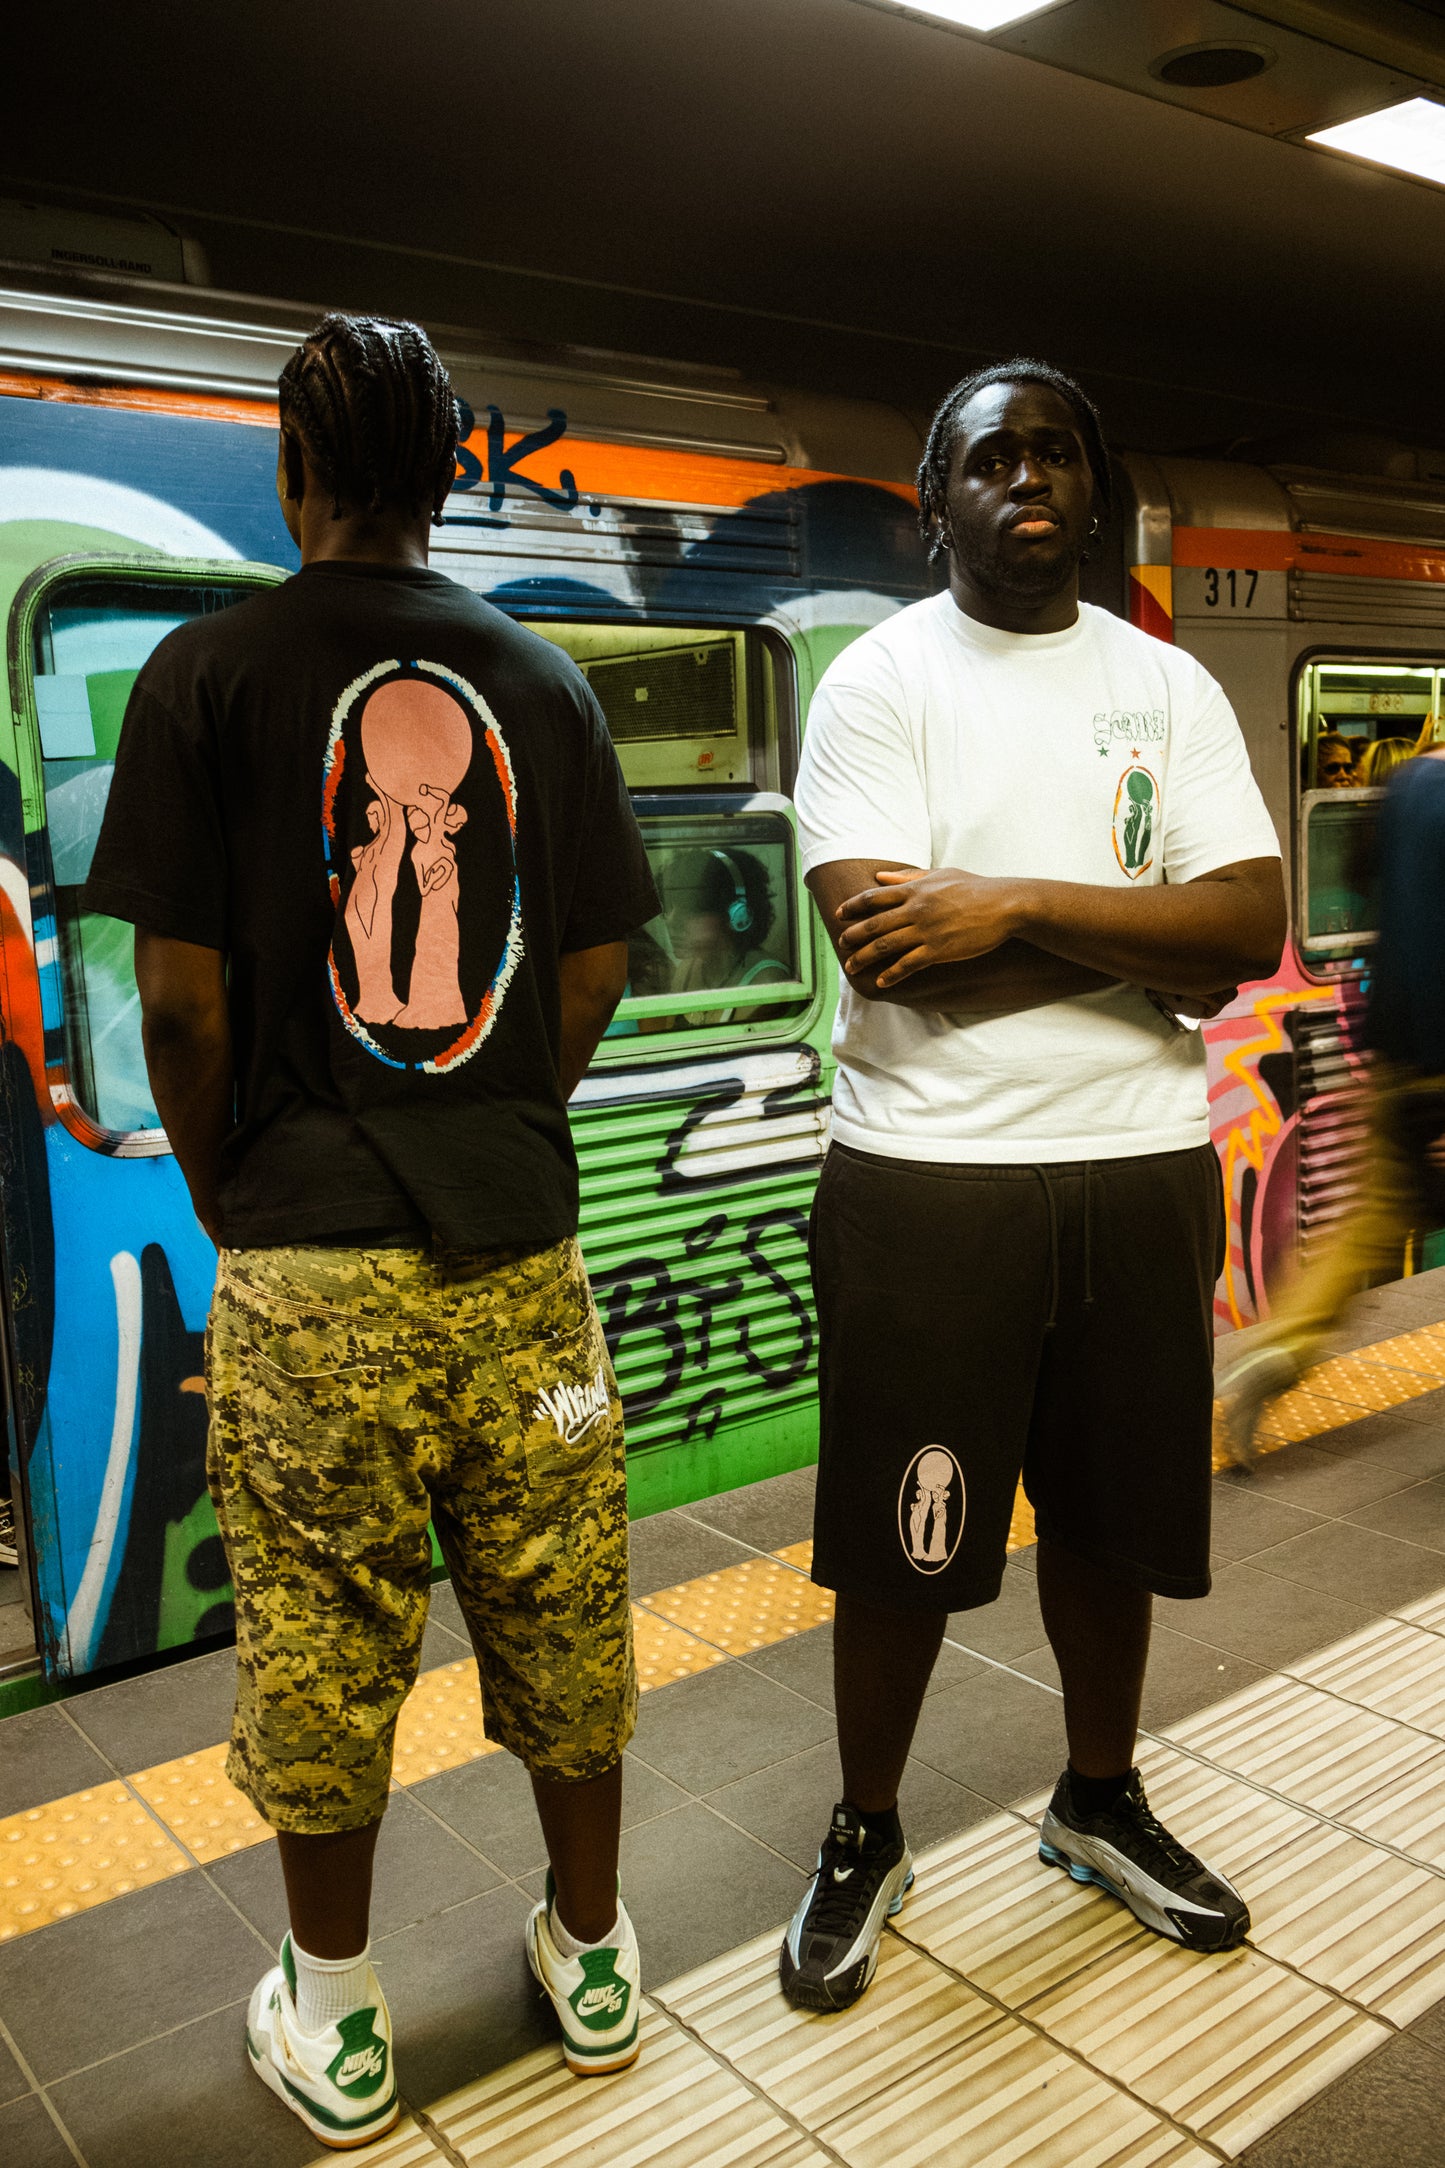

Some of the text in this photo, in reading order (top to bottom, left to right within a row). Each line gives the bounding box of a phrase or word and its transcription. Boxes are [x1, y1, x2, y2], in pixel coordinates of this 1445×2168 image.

[1205, 568, 1258, 608] 317
[583, 1983, 616, 2004] NIKE
[342, 2045, 375, 2074] NIKE
